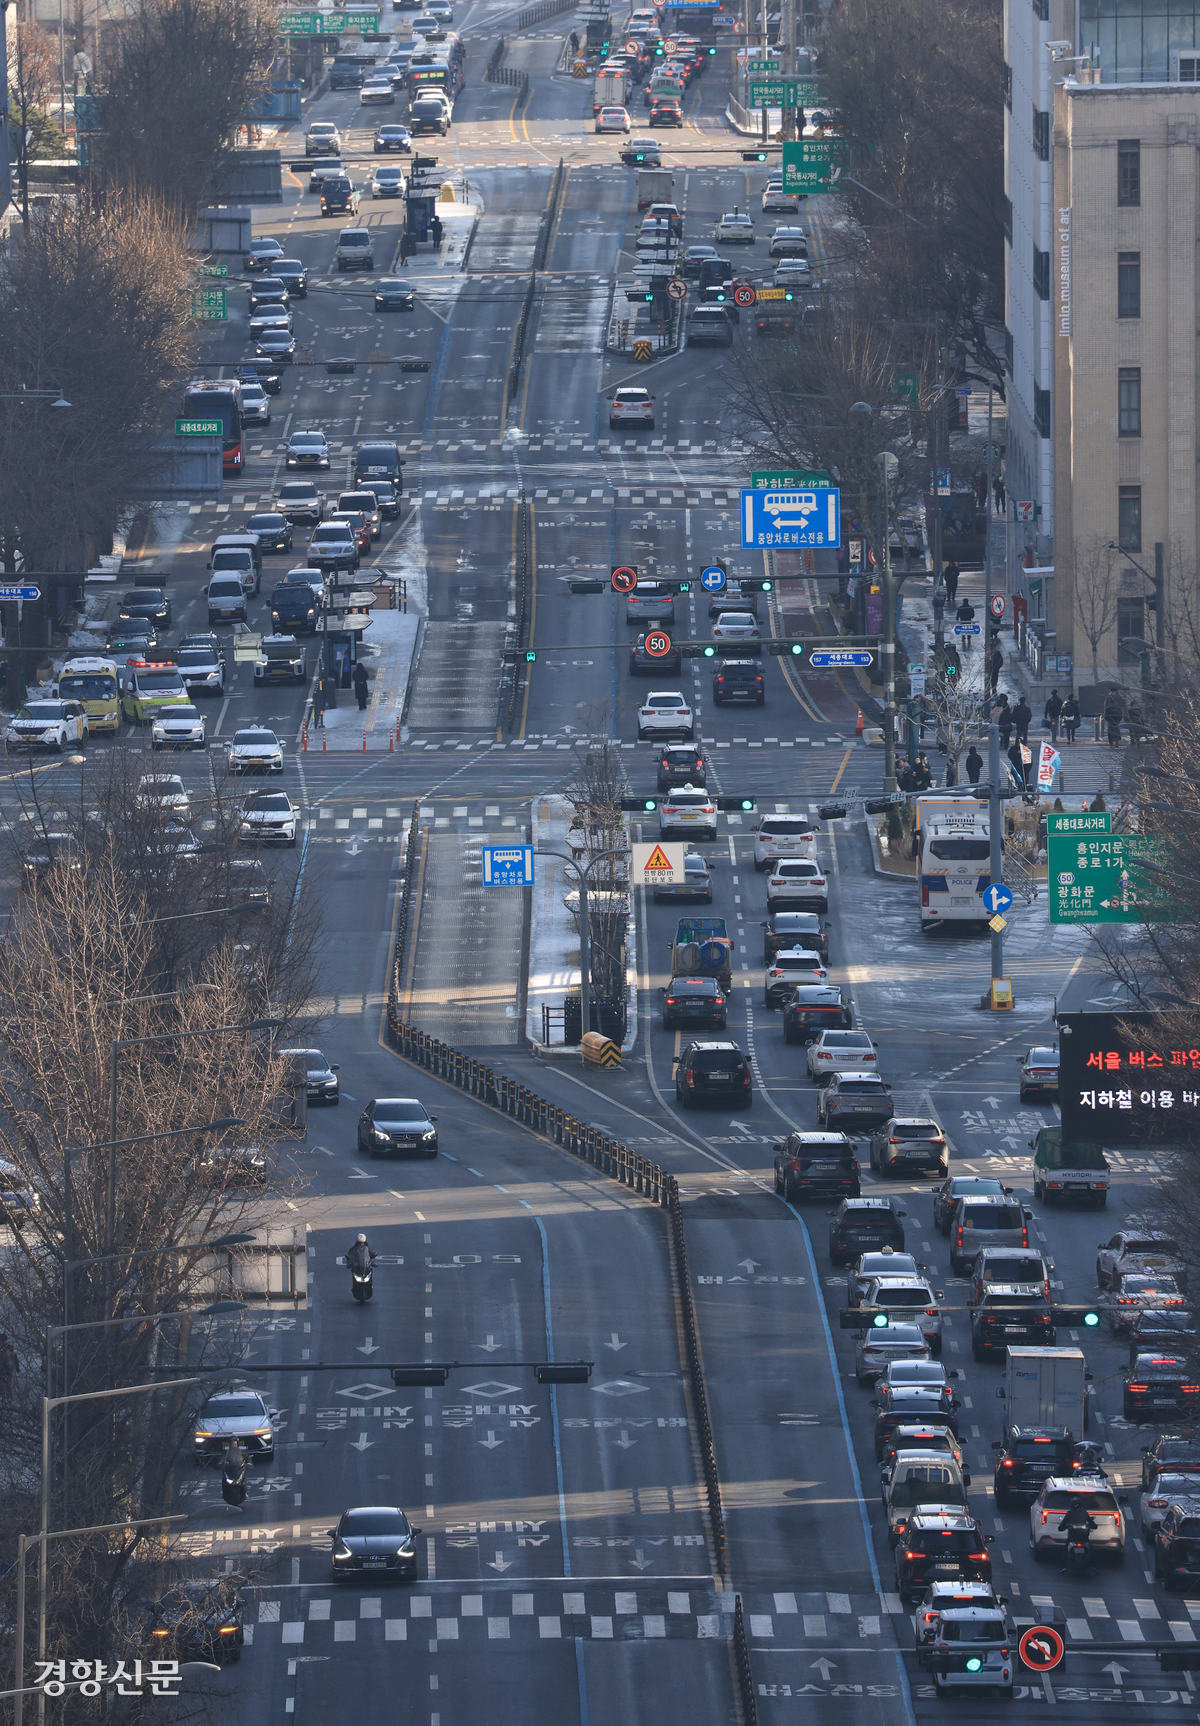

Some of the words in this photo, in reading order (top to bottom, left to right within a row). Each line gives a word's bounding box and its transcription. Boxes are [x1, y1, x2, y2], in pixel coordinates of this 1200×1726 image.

[1059, 206, 1069, 224] art
[1058, 228, 1069, 242] of
[1060, 246, 1070, 302] museum
[740, 292, 750, 301] 50
[1059, 306, 1070, 337] ilmin
[180, 423, 218, 432] 세종대로사거리
[758, 532, 824, 544] 중앙차로버스전용
[650, 638, 665, 650] 50
[947, 666, 956, 674] 23
[1055, 818, 1106, 830] 세종대로사거리
[1077, 842, 1124, 854] 흥인지문
[1077, 857, 1124, 868] 종로1가
[1058, 886, 1095, 898] 광화문
[1058, 899, 1092, 908] 光化門
[1058, 909, 1098, 917] Gwanghwamun
[1086, 1051, 1121, 1070] 서울
[1129, 1050, 1163, 1069] 버스
[1080, 1090, 1132, 1109] 지하철
[1140, 1090, 1174, 1108] 이용
[698, 1275, 808, 1285] 버스전용
[757, 1684, 900, 1698] 버스전용
[1054, 1687, 1194, 1704] 종로1가
